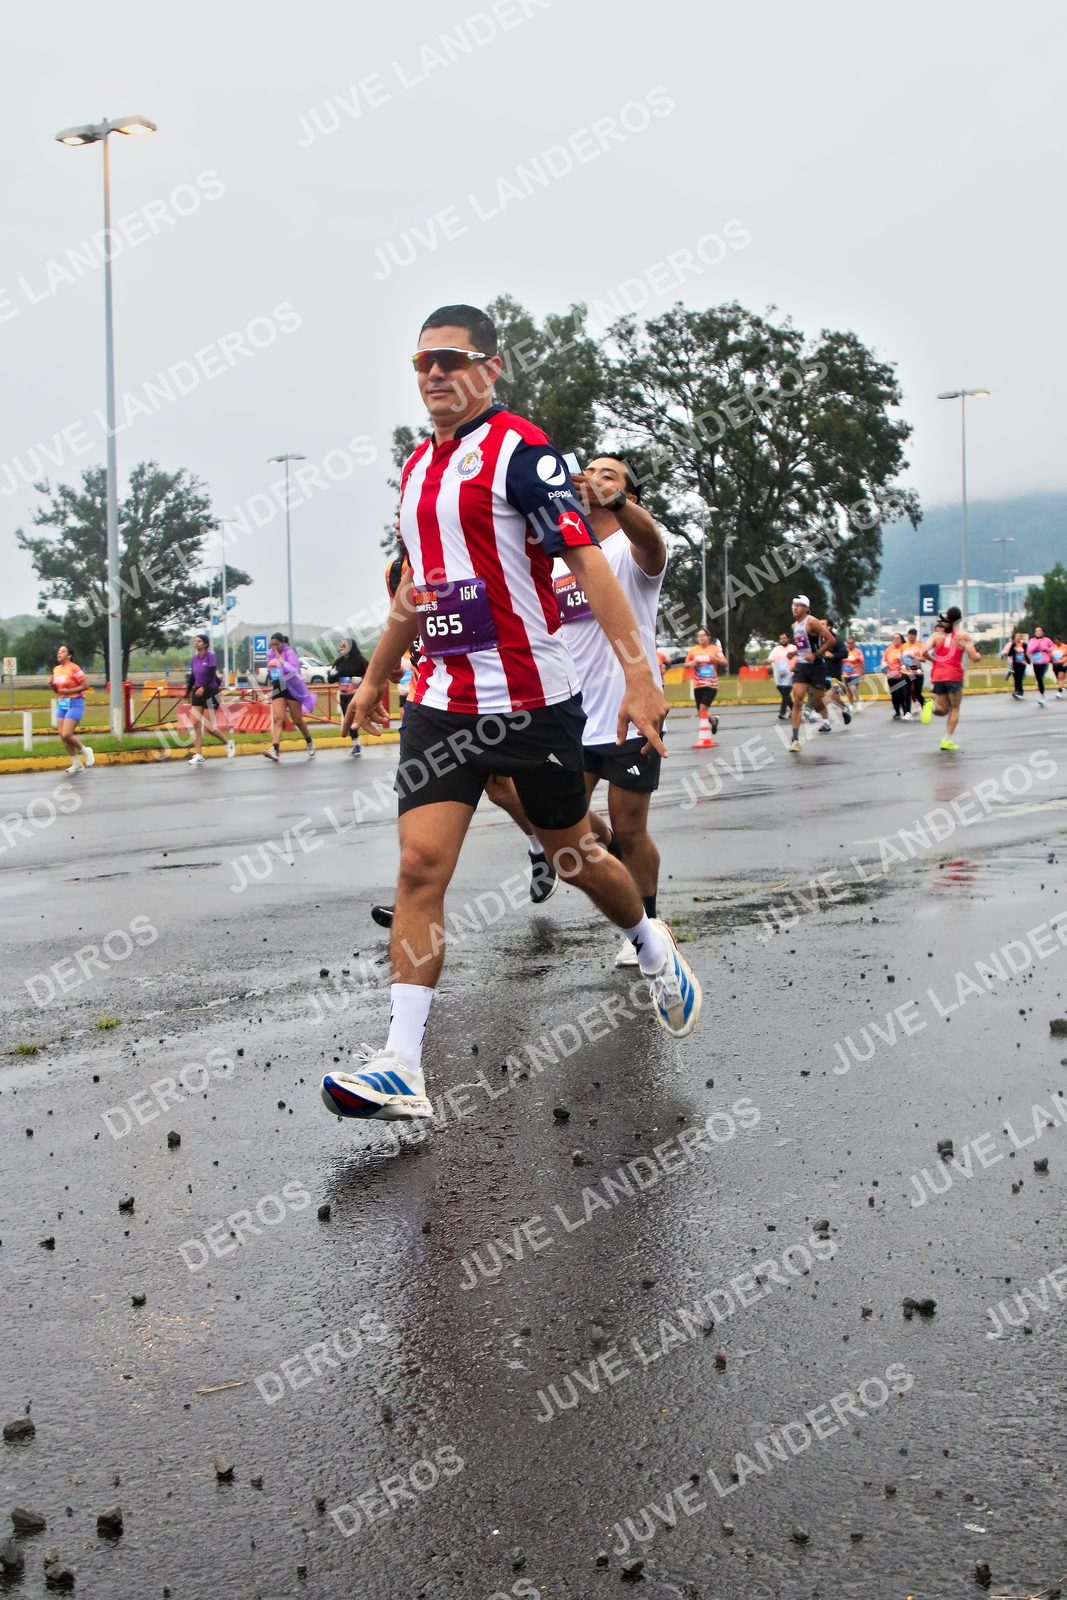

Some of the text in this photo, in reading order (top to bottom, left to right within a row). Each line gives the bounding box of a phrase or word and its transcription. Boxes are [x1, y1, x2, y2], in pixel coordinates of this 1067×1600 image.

[459, 585, 478, 600] 15K
[923, 597, 934, 612] E
[426, 613, 463, 637] 655
